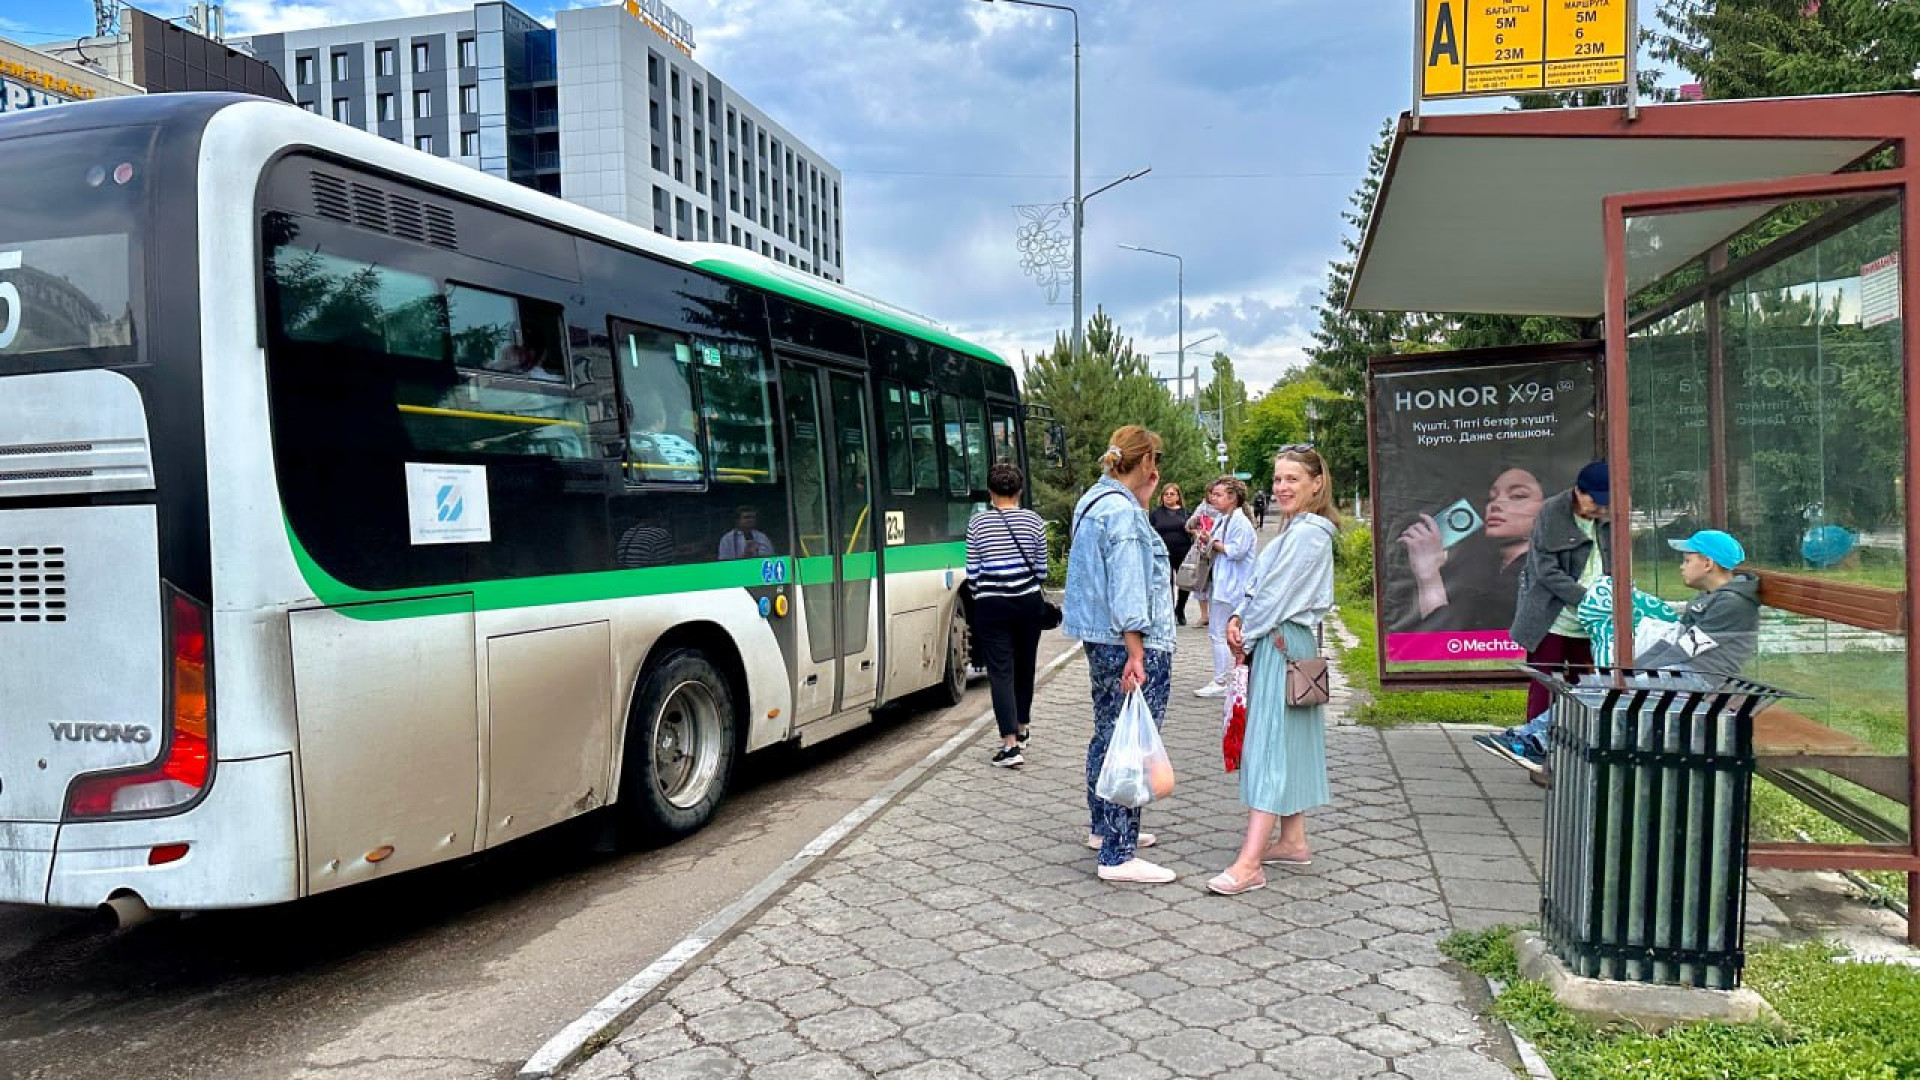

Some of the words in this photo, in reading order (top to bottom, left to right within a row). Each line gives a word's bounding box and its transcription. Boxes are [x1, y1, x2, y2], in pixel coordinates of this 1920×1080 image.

[1496, 18, 1516, 29] 5М
[1576, 11, 1597, 23] 5М
[1428, 2, 1459, 66] А
[1495, 34, 1504, 45] 6
[1575, 27, 1584, 39] 6
[1495, 48, 1524, 60] 23М
[1575, 42, 1604, 55] 23М
[1395, 386, 1499, 411] HONOR
[1508, 381, 1553, 404] X9a
[1453, 416, 1480, 430] Тіпті
[1483, 415, 1518, 429] бетер
[1417, 433, 1456, 447] Круто.
[1459, 431, 1493, 444] Даже
[1496, 427, 1555, 440] слишком.
[48, 722, 152, 744] YUTONG
